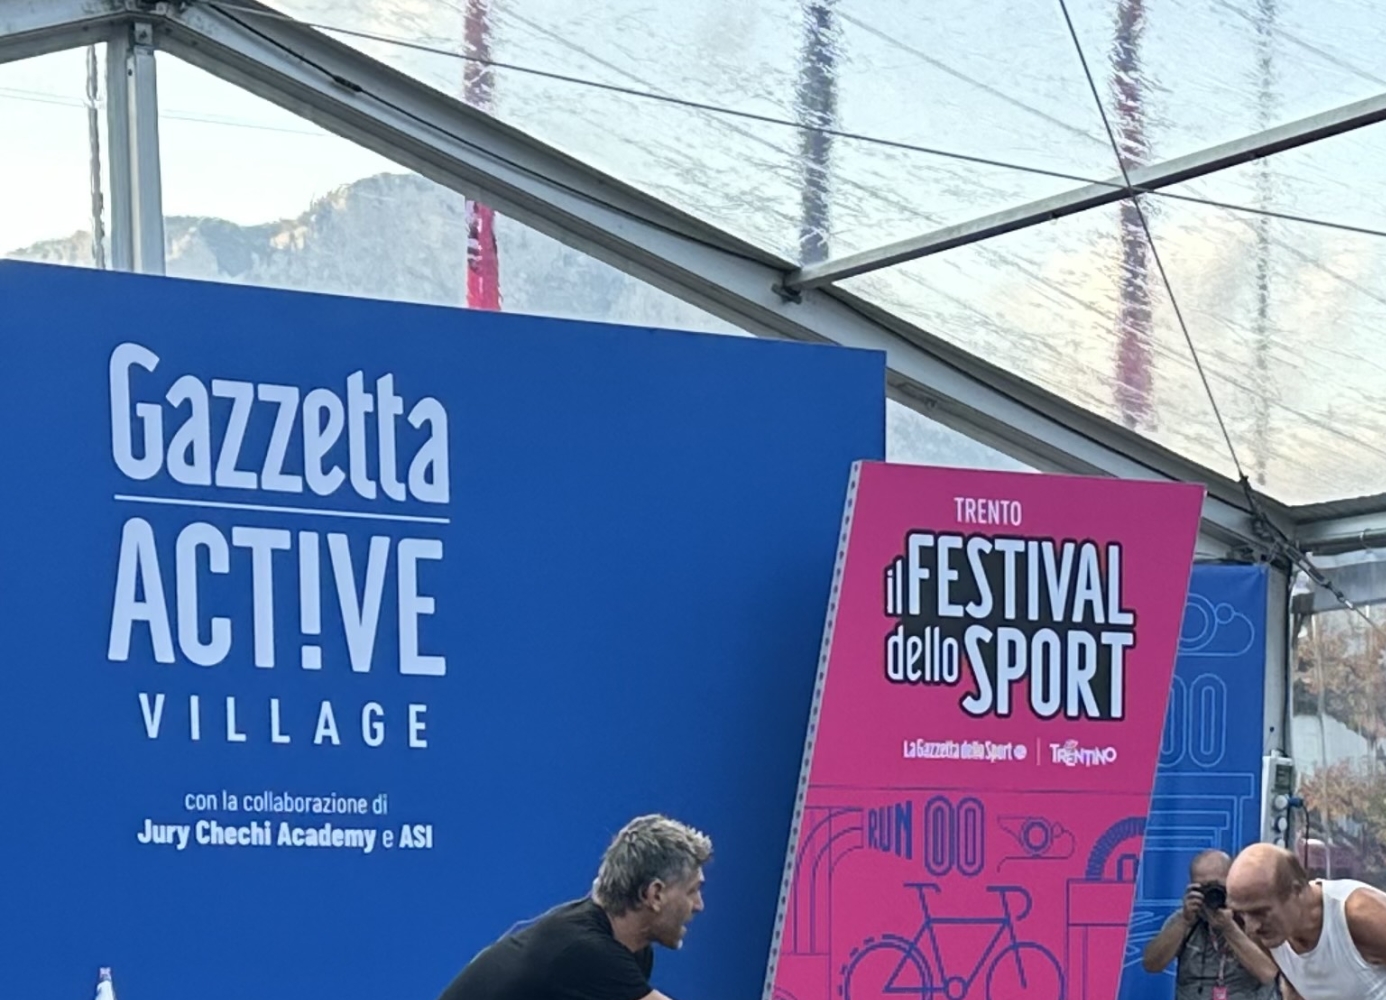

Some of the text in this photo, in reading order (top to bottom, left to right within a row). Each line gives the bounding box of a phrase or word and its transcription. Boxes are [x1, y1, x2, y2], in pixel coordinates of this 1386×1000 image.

[109, 342, 450, 503] Gazzetta
[954, 497, 1022, 526] TRENTO
[108, 517, 446, 676] ACT!VE
[887, 533, 1134, 625] il FESTIVAL
[887, 624, 1134, 718] dello SPORT
[139, 693, 428, 748] VILLAGE
[185, 790, 388, 815] con la collaborazione di
[868, 799, 912, 860] RUN
[137, 818, 432, 854] Jury Chechi Academy e ASI
